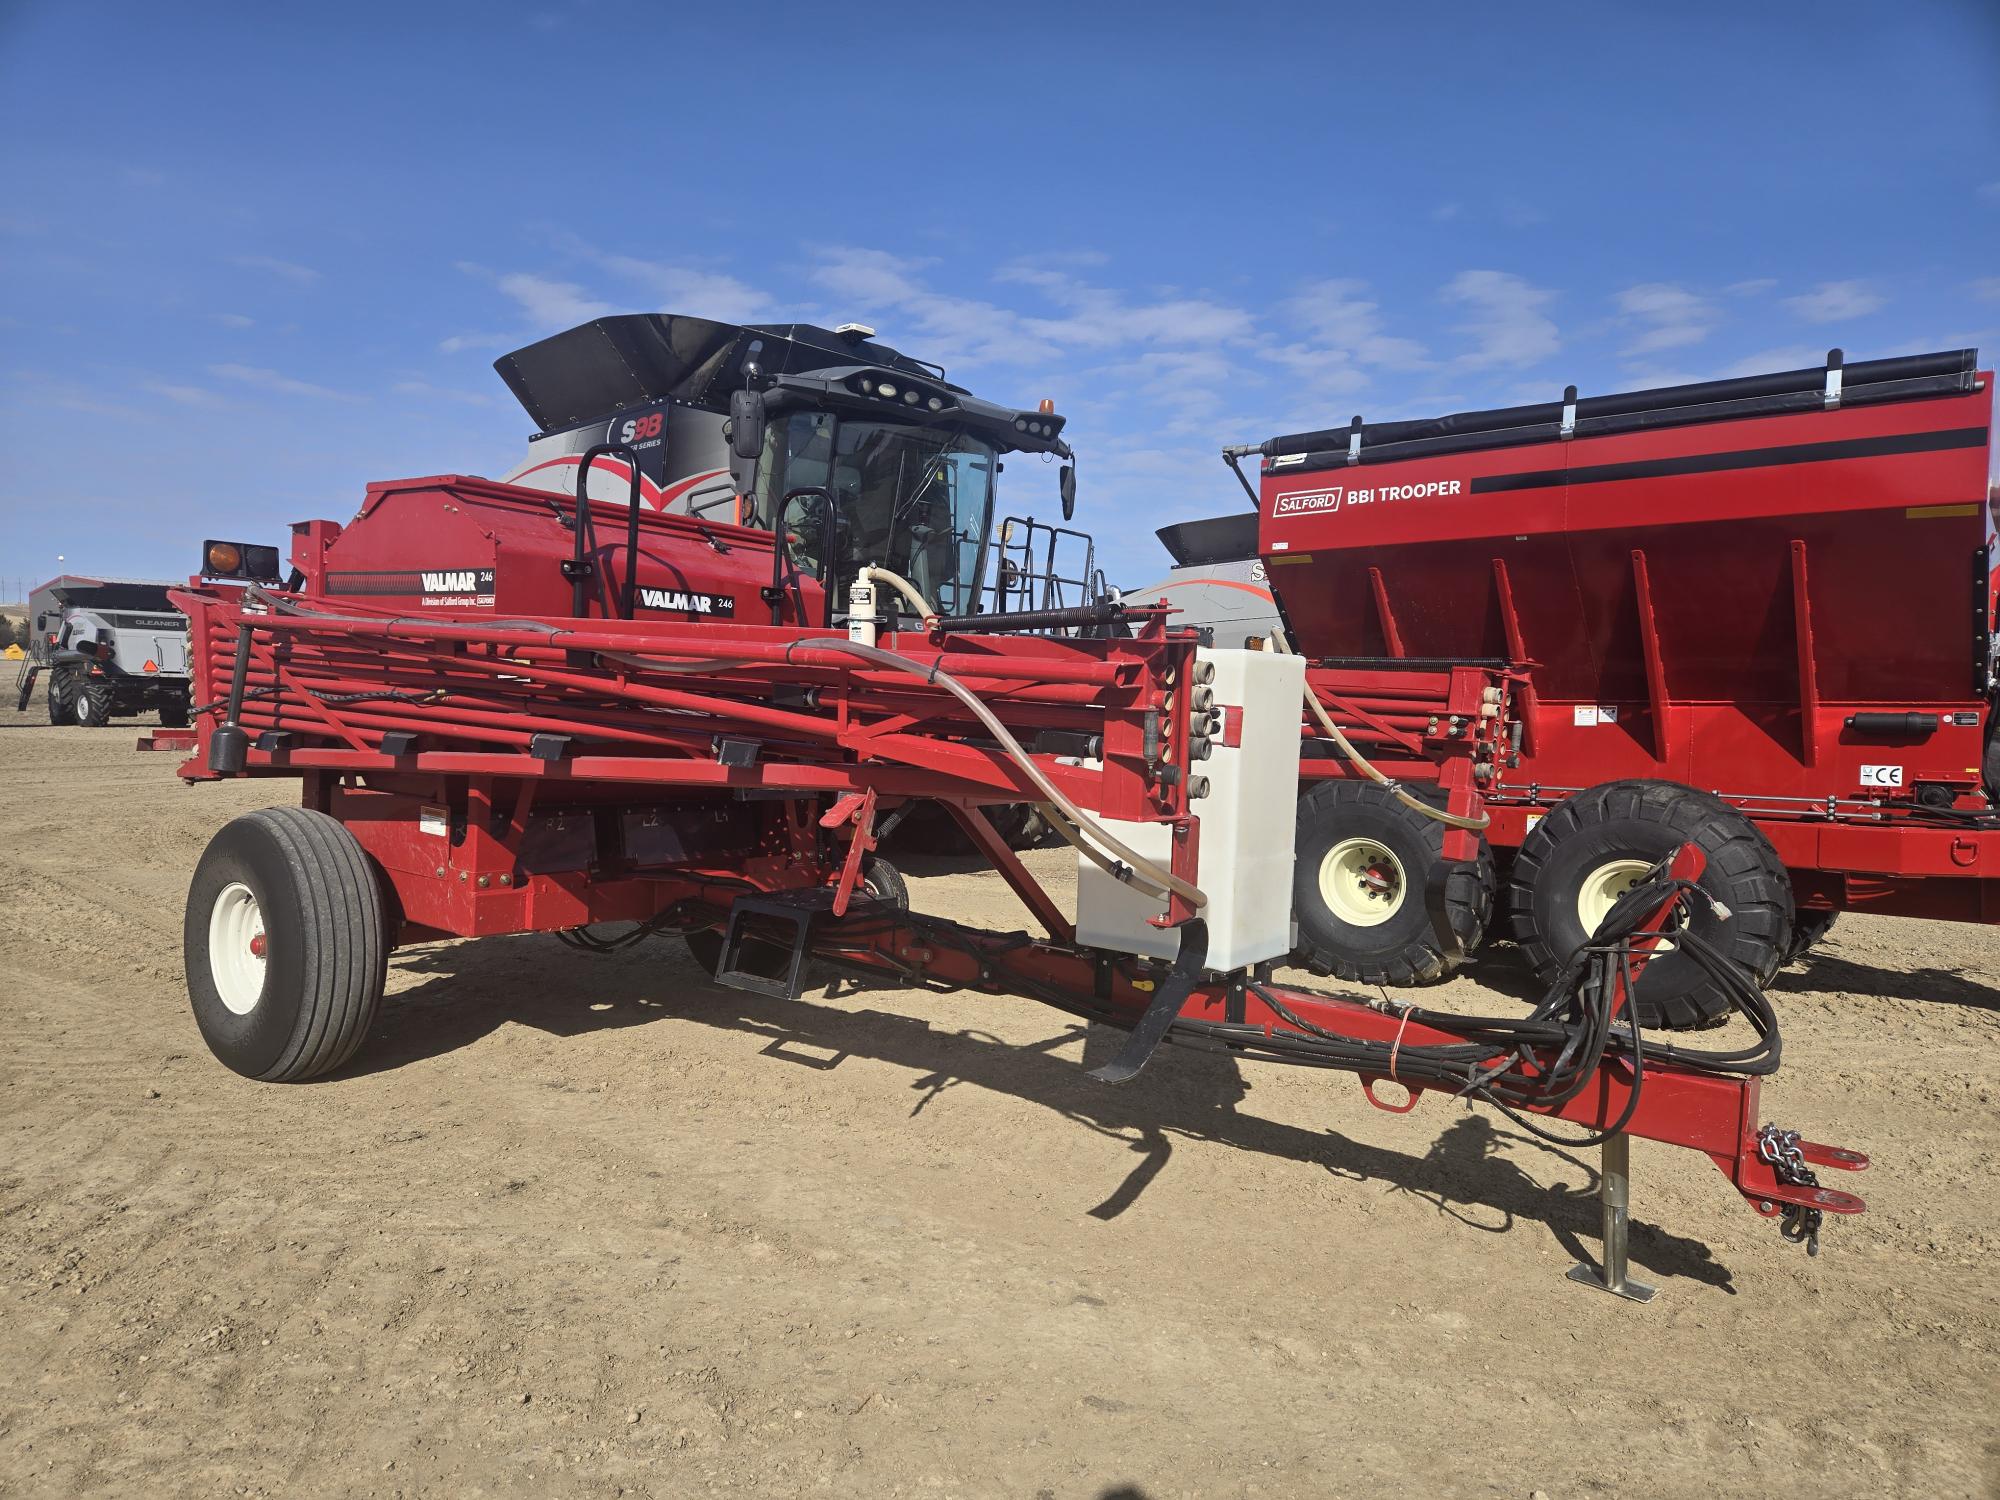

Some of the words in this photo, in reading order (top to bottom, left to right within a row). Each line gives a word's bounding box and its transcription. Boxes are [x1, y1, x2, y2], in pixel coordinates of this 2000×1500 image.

[620, 413, 664, 443] S98
[638, 438, 662, 450] SERIES
[1279, 493, 1336, 512] SALFORD
[1347, 489, 1375, 505] BBI
[1379, 480, 1461, 502] TROOPER
[421, 573, 476, 592] VALMAR
[480, 571, 493, 582] 246
[641, 588, 712, 613] VALMAR
[718, 598, 733, 609] 246
[135, 619, 180, 627] GLEANER
[1875, 767, 1901, 784] CE
